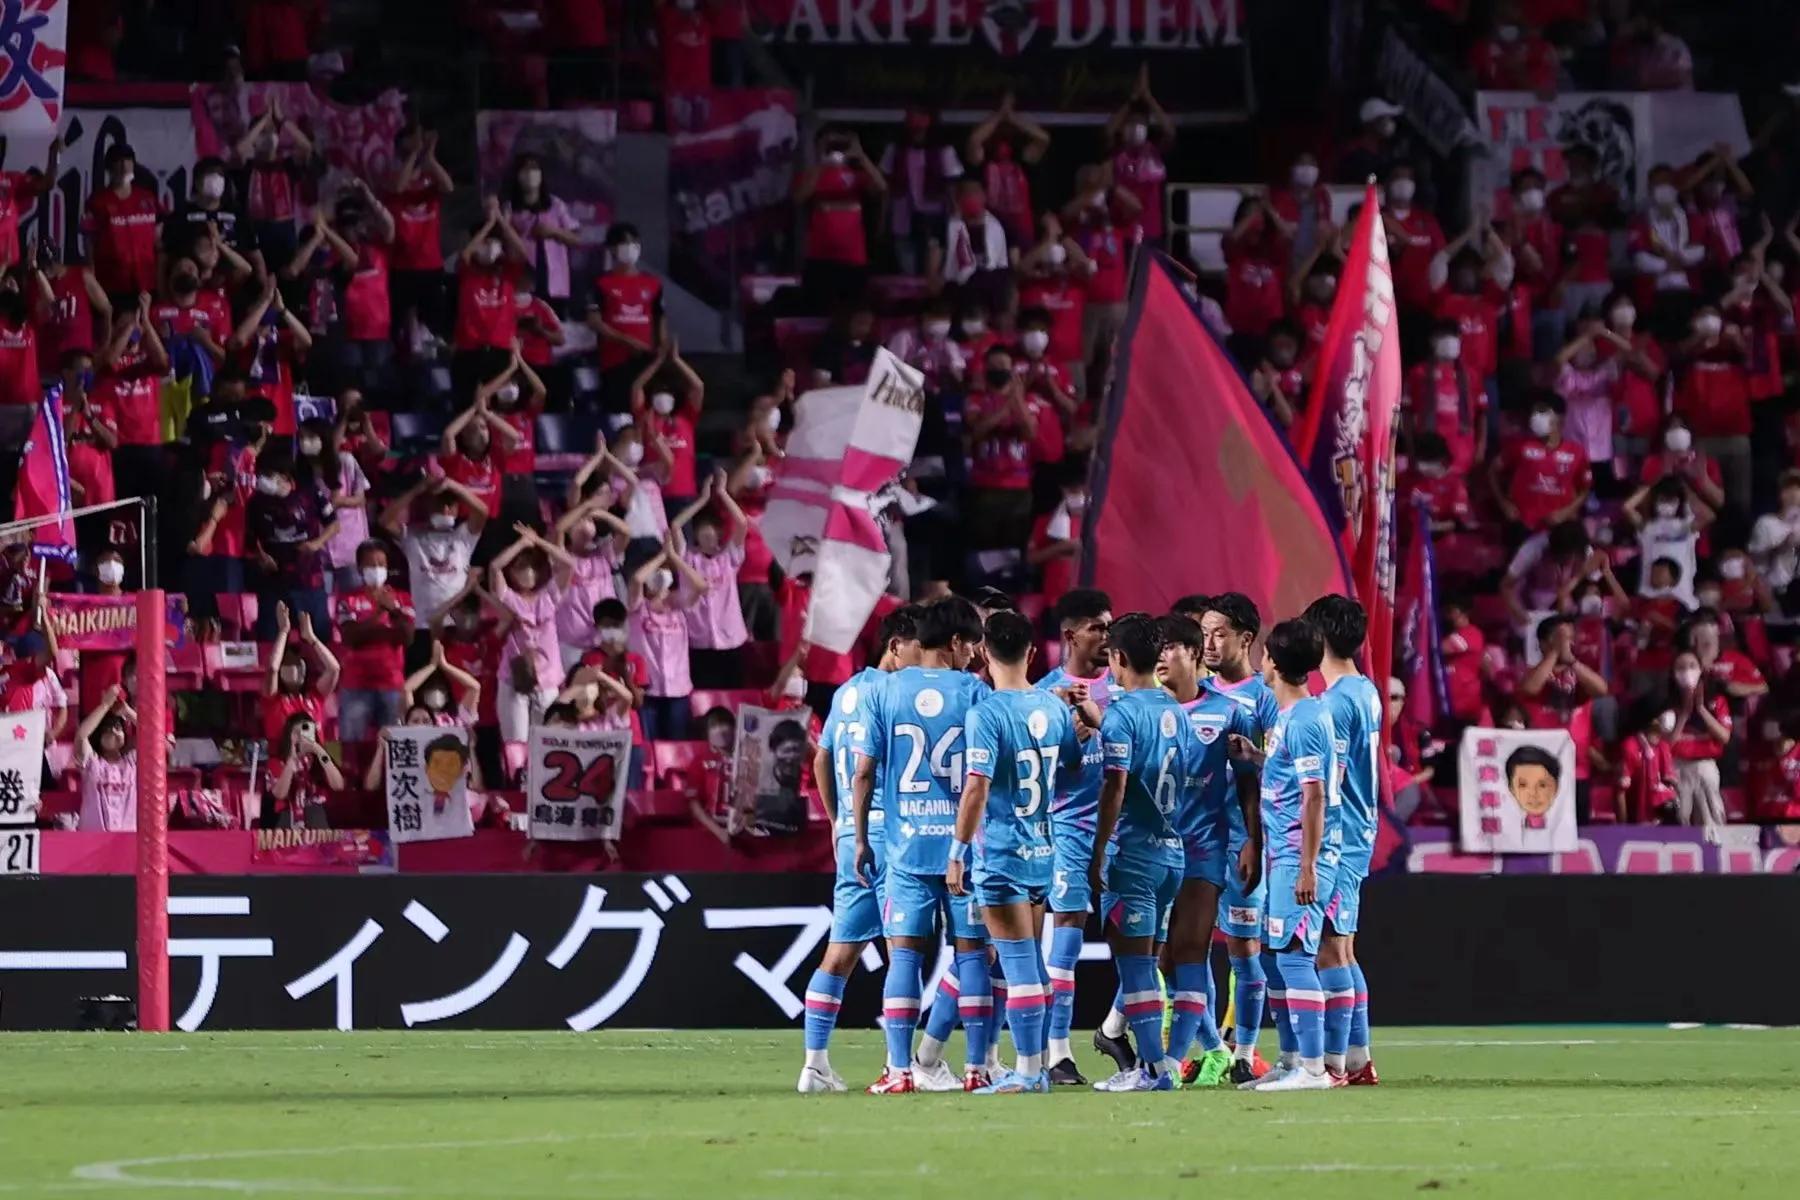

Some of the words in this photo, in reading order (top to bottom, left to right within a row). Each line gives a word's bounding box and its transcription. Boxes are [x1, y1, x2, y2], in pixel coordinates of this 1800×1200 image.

[757, 0, 974, 44] ARPE
[1052, 0, 1242, 48] DIEM
[541, 750, 616, 805] 24
[894, 723, 966, 795] 24
[1014, 744, 1060, 818] 37
[1154, 746, 1177, 815] 6
[7, 833, 34, 871] 21
[1055, 870, 1068, 899] 5
